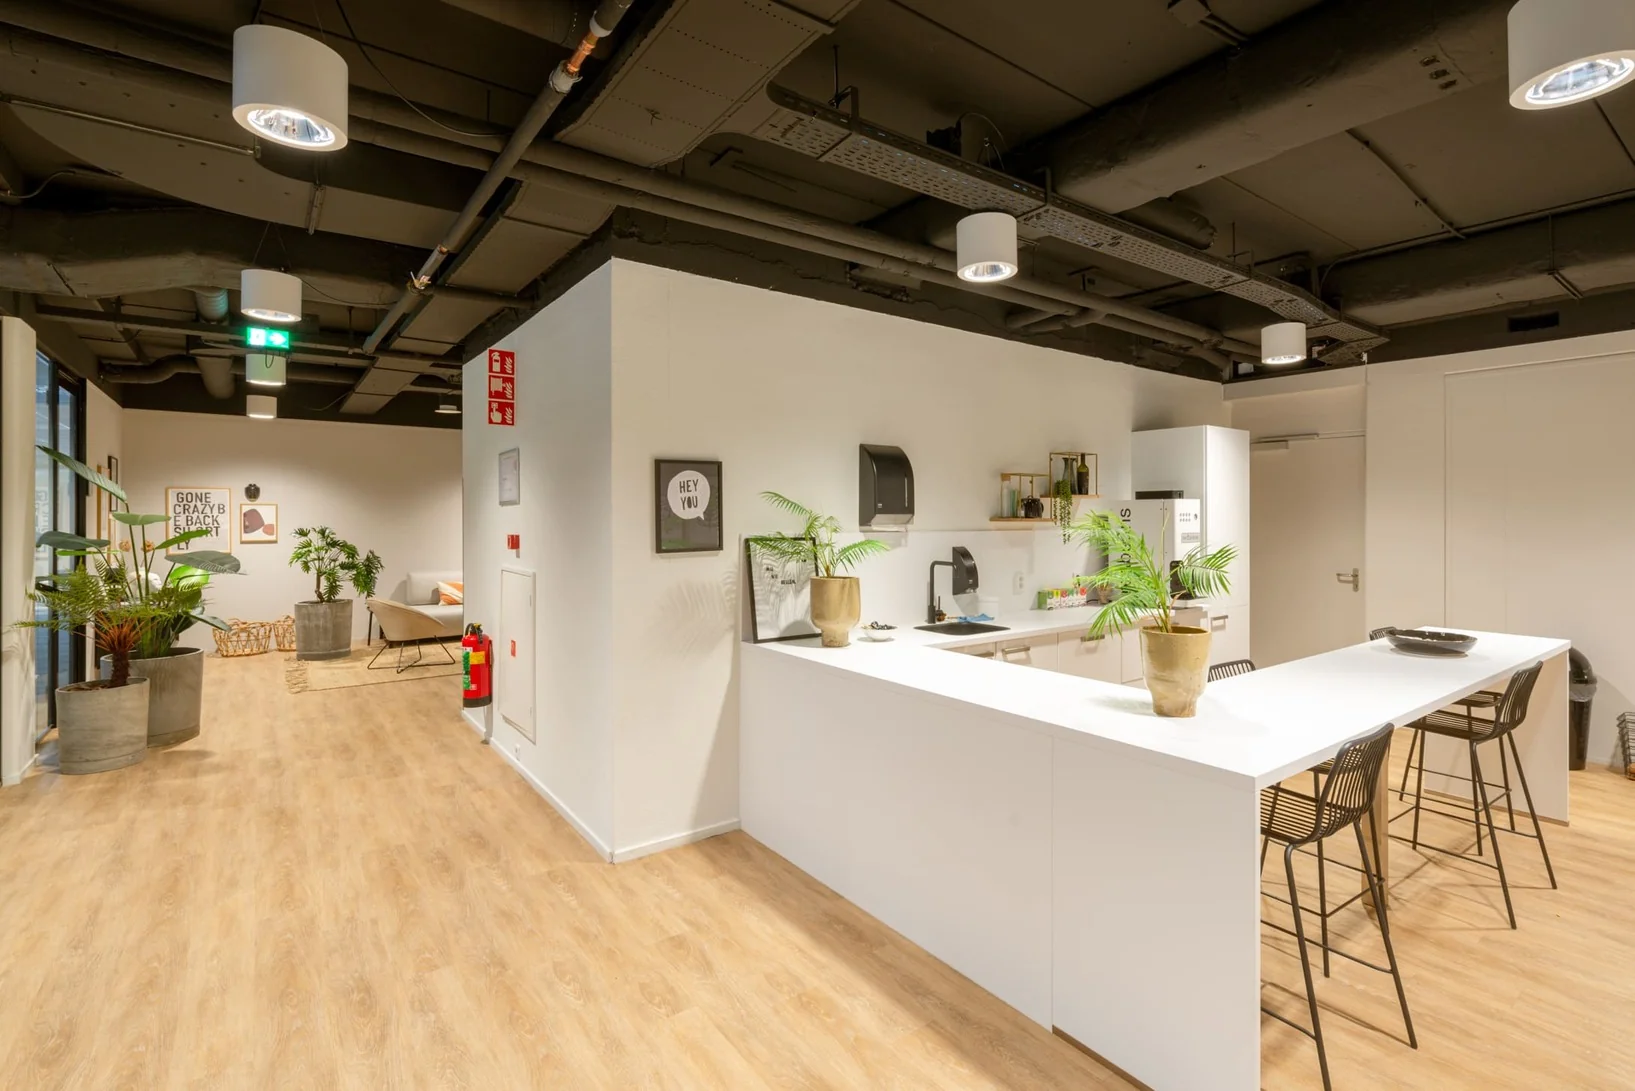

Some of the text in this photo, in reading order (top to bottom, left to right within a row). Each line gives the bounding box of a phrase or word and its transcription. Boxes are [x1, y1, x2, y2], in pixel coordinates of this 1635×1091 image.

[679, 479, 698, 493] HEY
[176, 492, 212, 503] GONE
[681, 496, 698, 510] YOU
[173, 503, 215, 515] CRAZY
[186, 515, 220, 526] BACK
